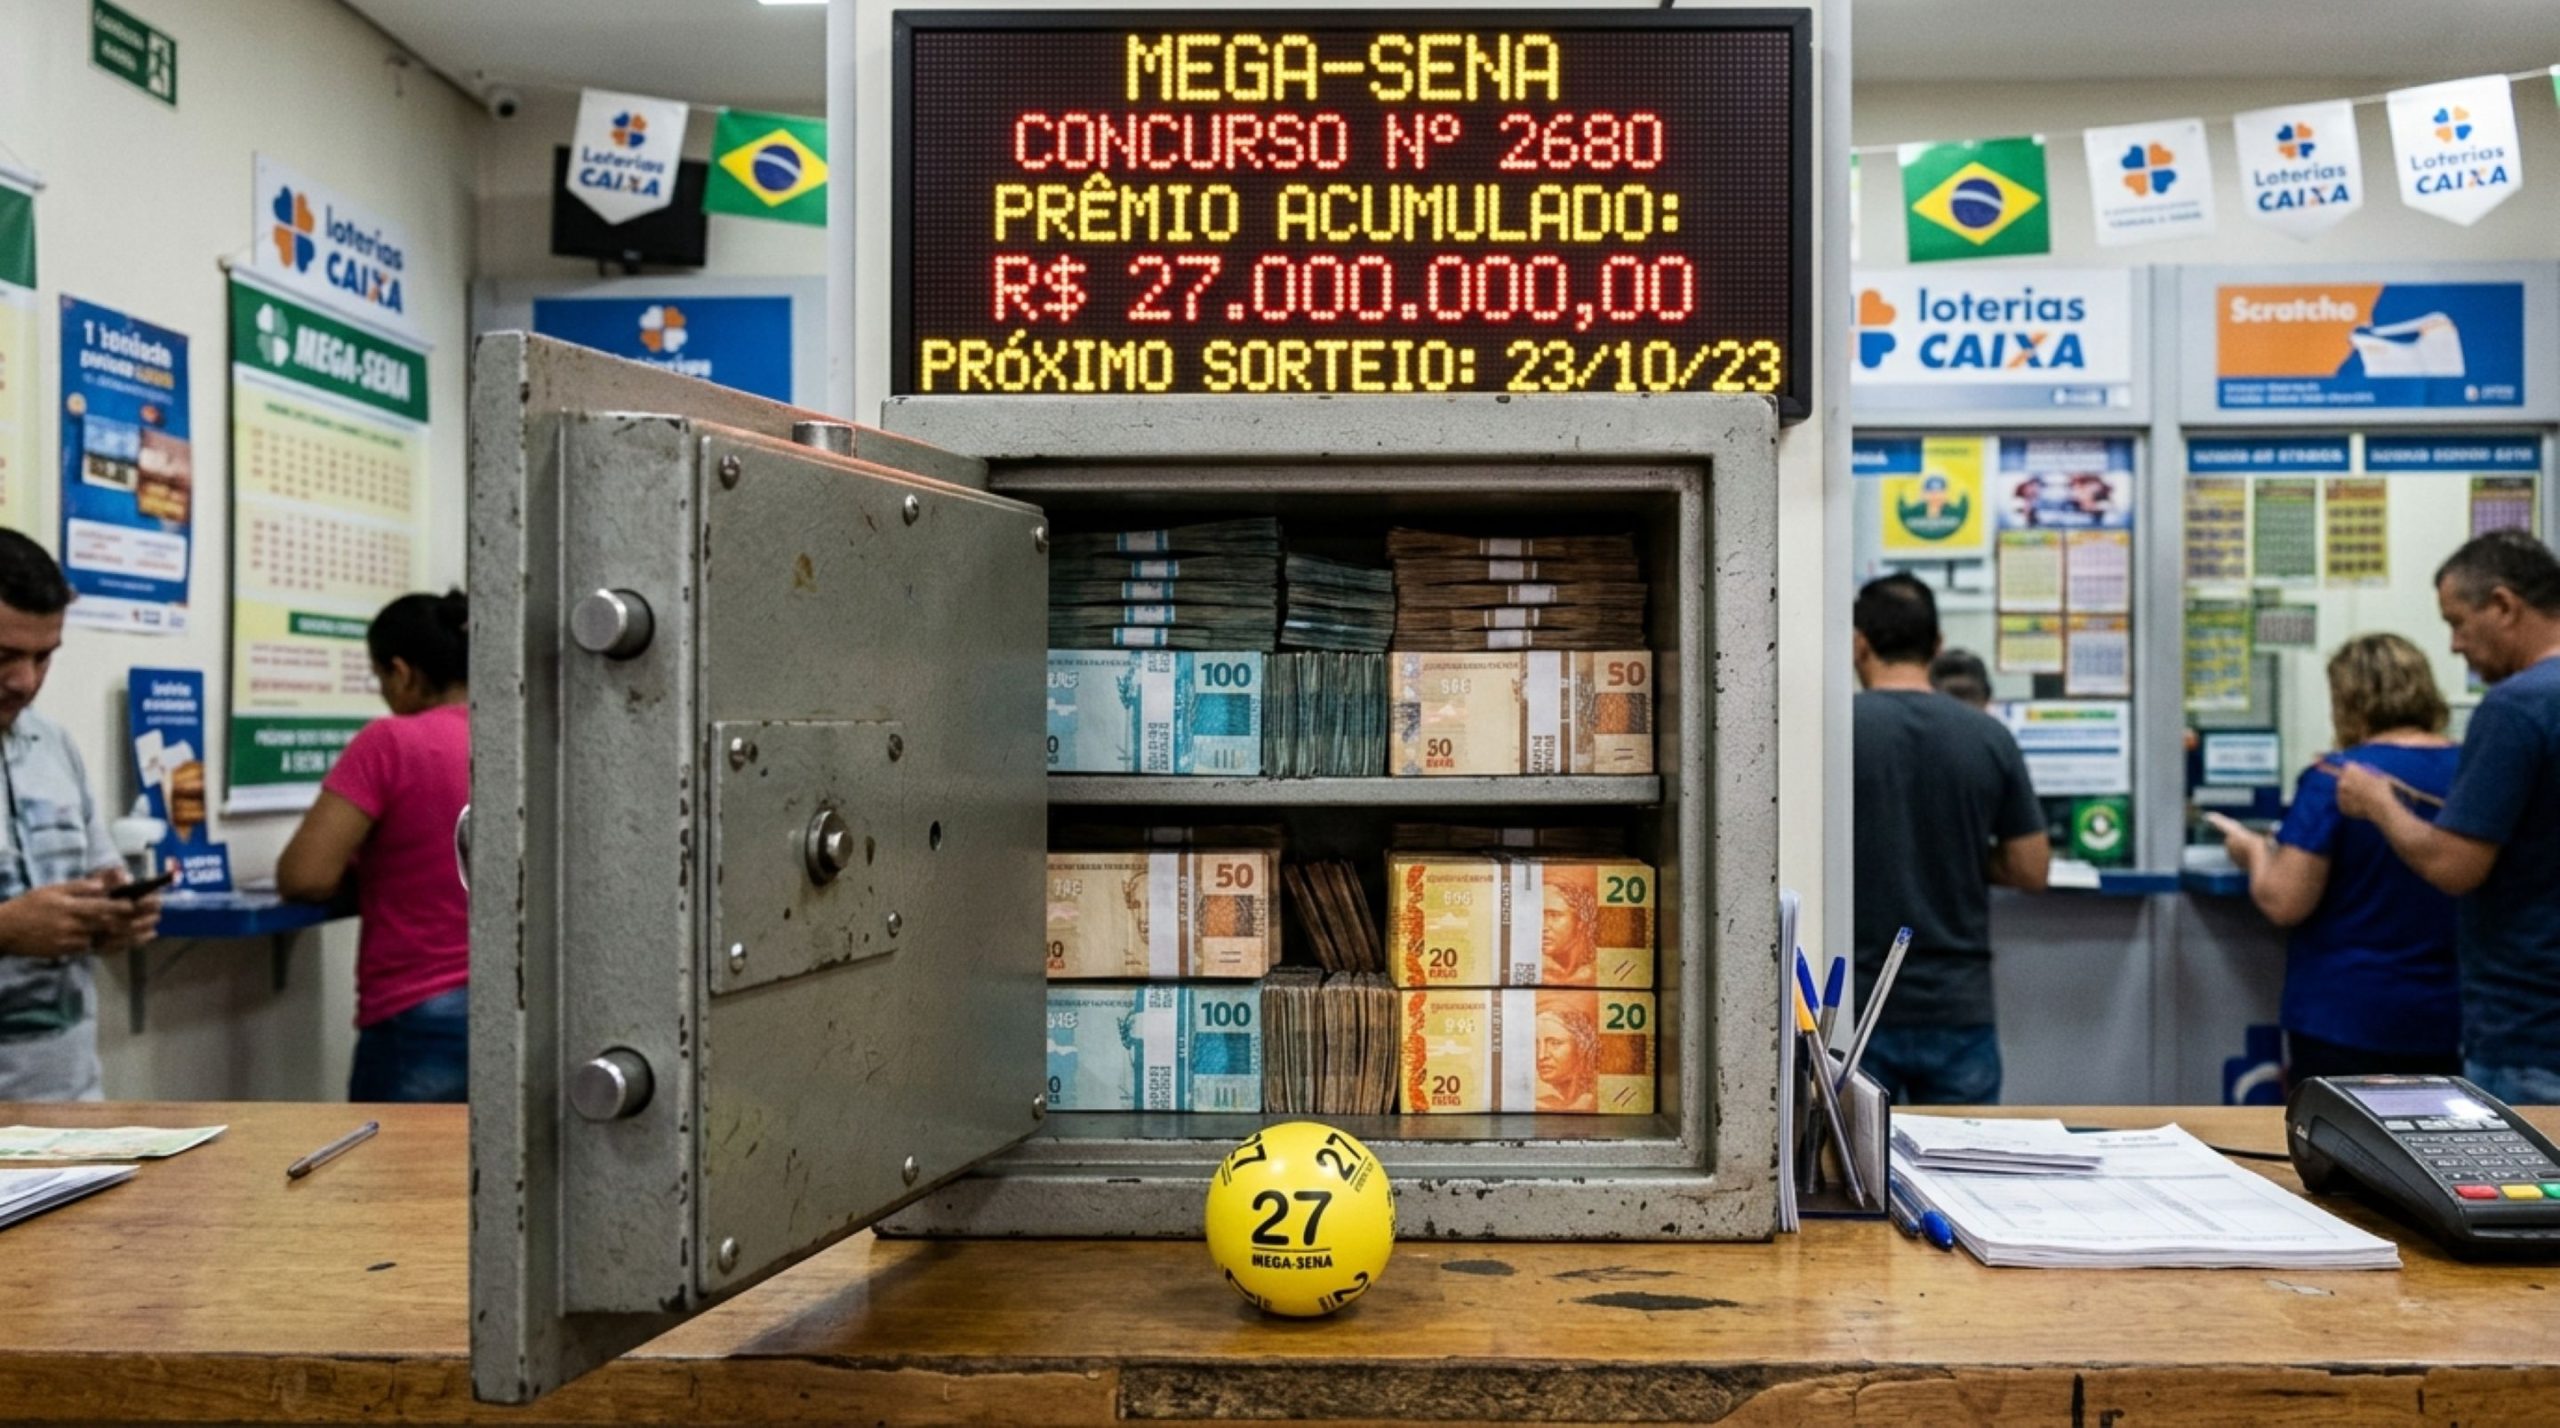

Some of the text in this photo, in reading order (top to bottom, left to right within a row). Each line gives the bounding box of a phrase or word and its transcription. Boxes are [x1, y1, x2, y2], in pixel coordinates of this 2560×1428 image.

[1127, 34, 1559, 101] MEGA-SENA
[1015, 112, 1347, 170] CONCURSO
[1500, 112, 1662, 170] 2680
[583, 145, 664, 174] Loterias
[2410, 146, 2505, 171] Loterias
[580, 168, 659, 197] CAIXA
[2254, 163, 2348, 187] Loterias
[2415, 165, 2509, 194] CAIXA
[996, 173, 1678, 241] PRÊMIO ACUMULADO:
[2257, 184, 2351, 212] CAIXA
[326, 205, 403, 272] loterias
[326, 252, 403, 315] CAIXA
[994, 254, 1693, 331] R$ 27.000.000,00
[1919, 287, 2086, 323] loterias
[294, 325, 410, 402] MEGA-SENA
[922, 330, 1781, 392] PRÓXIMO SORTEIO: 23/10/23
[1919, 332, 2086, 369] CAIXA
[1201, 662, 1252, 688] 100
[1215, 863, 1254, 889] 50
[1606, 876, 1646, 904] 20
[1429, 948, 1458, 968] 20
[1201, 1001, 1252, 1027] 100
[1606, 1003, 1646, 1030] 20
[1432, 1075, 1461, 1094] 20
[1315, 1132, 1362, 1182] 27
[1251, 1190, 1333, 1247] 27
[1252, 1254, 1333, 1270] MEGA-SENA
